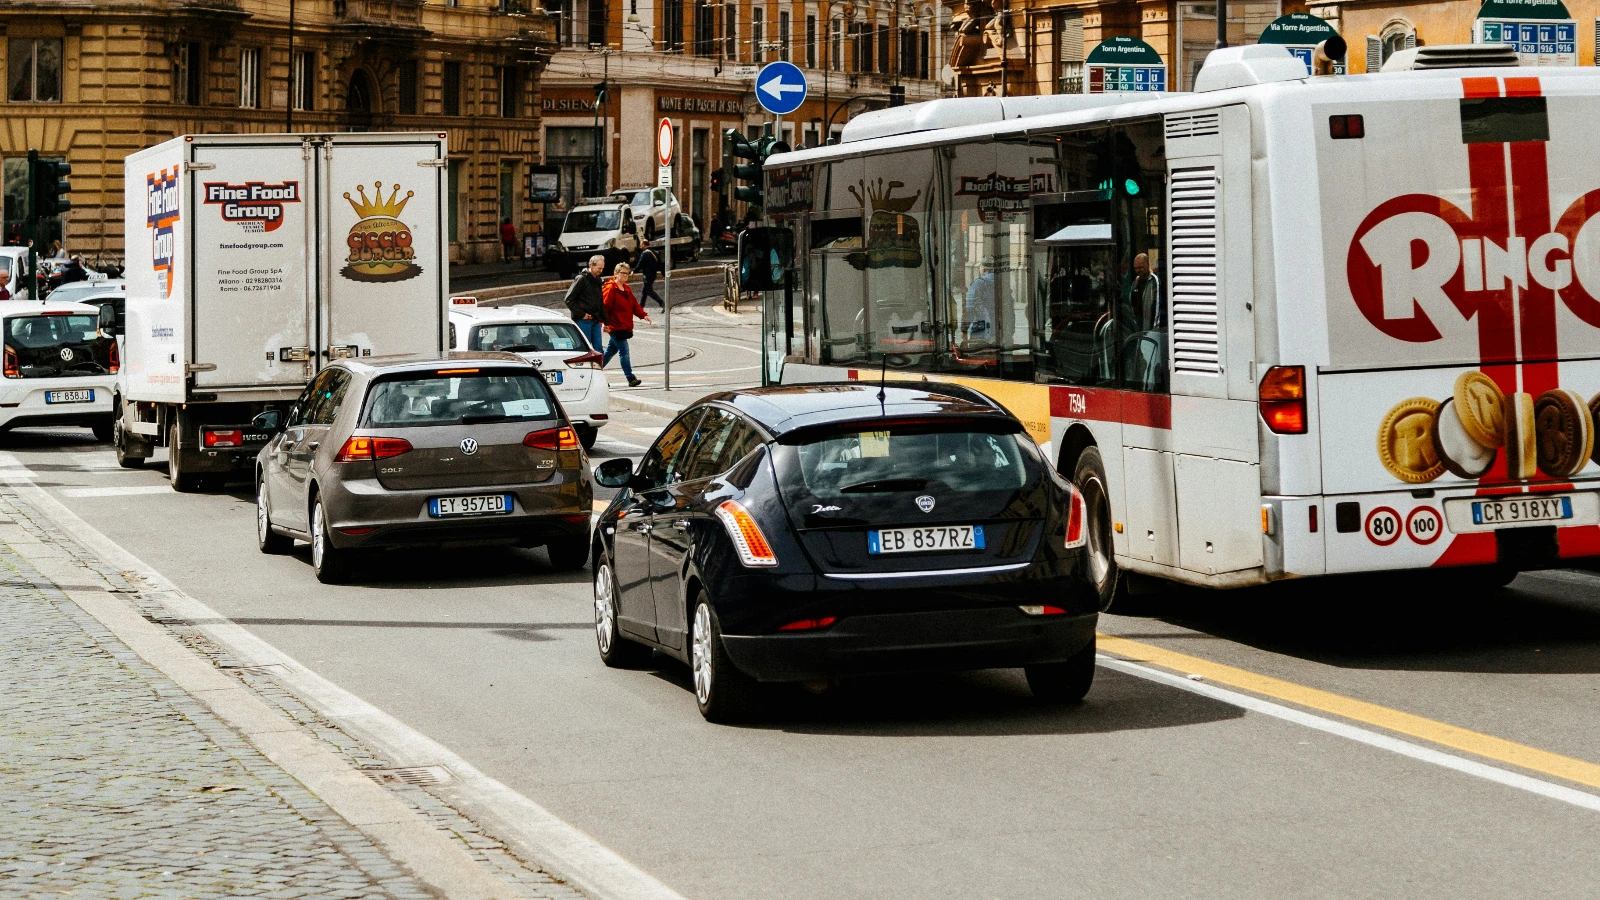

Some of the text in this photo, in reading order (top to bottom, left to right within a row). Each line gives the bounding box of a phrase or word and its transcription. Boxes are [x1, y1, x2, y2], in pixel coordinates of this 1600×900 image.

[1270, 23, 1330, 33] Via Torre Argentina
[1117, 45, 1145, 53] Argentina
[1522, 44, 1536, 53] 628
[1541, 44, 1554, 53] 916
[1558, 43, 1572, 53] 916
[1333, 66, 1343, 75] 30
[543, 99, 597, 110] DI SIENA
[660, 96, 744, 114] MONTE DEI PASCHI DI SIENA
[148, 177, 179, 217] Fine Food
[209, 185, 295, 201] Fine Food
[225, 203, 280, 220] Group
[153, 228, 173, 266] Group
[219, 242, 284, 250] finefoodgroup.com
[347, 231, 412, 249] CICCIO
[348, 247, 414, 261] BURGER
[1353, 208, 1600, 329] RING
[51, 389, 90, 400] FF 838JJ
[1068, 393, 1086, 414] 7594
[439, 498, 456, 513] EY
[460, 496, 503, 512] 957ED
[1483, 503, 1504, 522] CR
[1509, 499, 1560, 519] 918XY
[1372, 516, 1395, 537] 80
[1413, 517, 1435, 534] 100
[881, 530, 905, 551] EB
[913, 527, 973, 549] 837RZ
